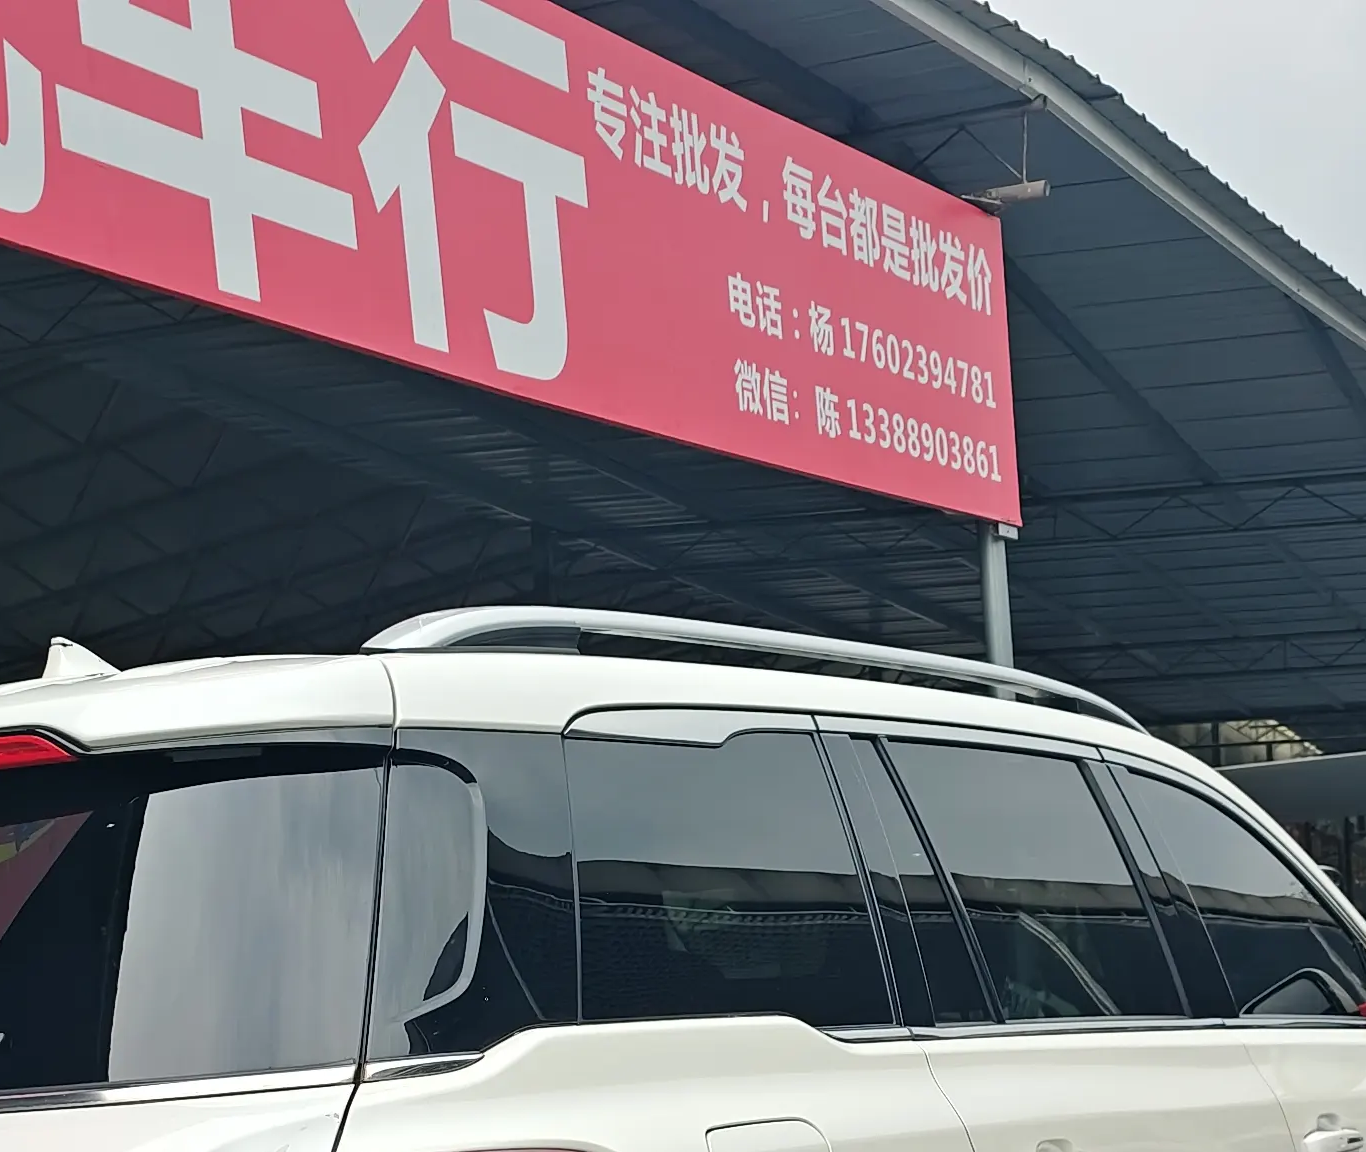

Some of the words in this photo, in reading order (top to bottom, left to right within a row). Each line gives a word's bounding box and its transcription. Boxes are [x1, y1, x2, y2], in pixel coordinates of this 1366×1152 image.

[586, 67, 992, 316] 专注批发，每台都是批发价
[841, 317, 997, 409] 17602394781
[847, 399, 1002, 482] 13388903861
